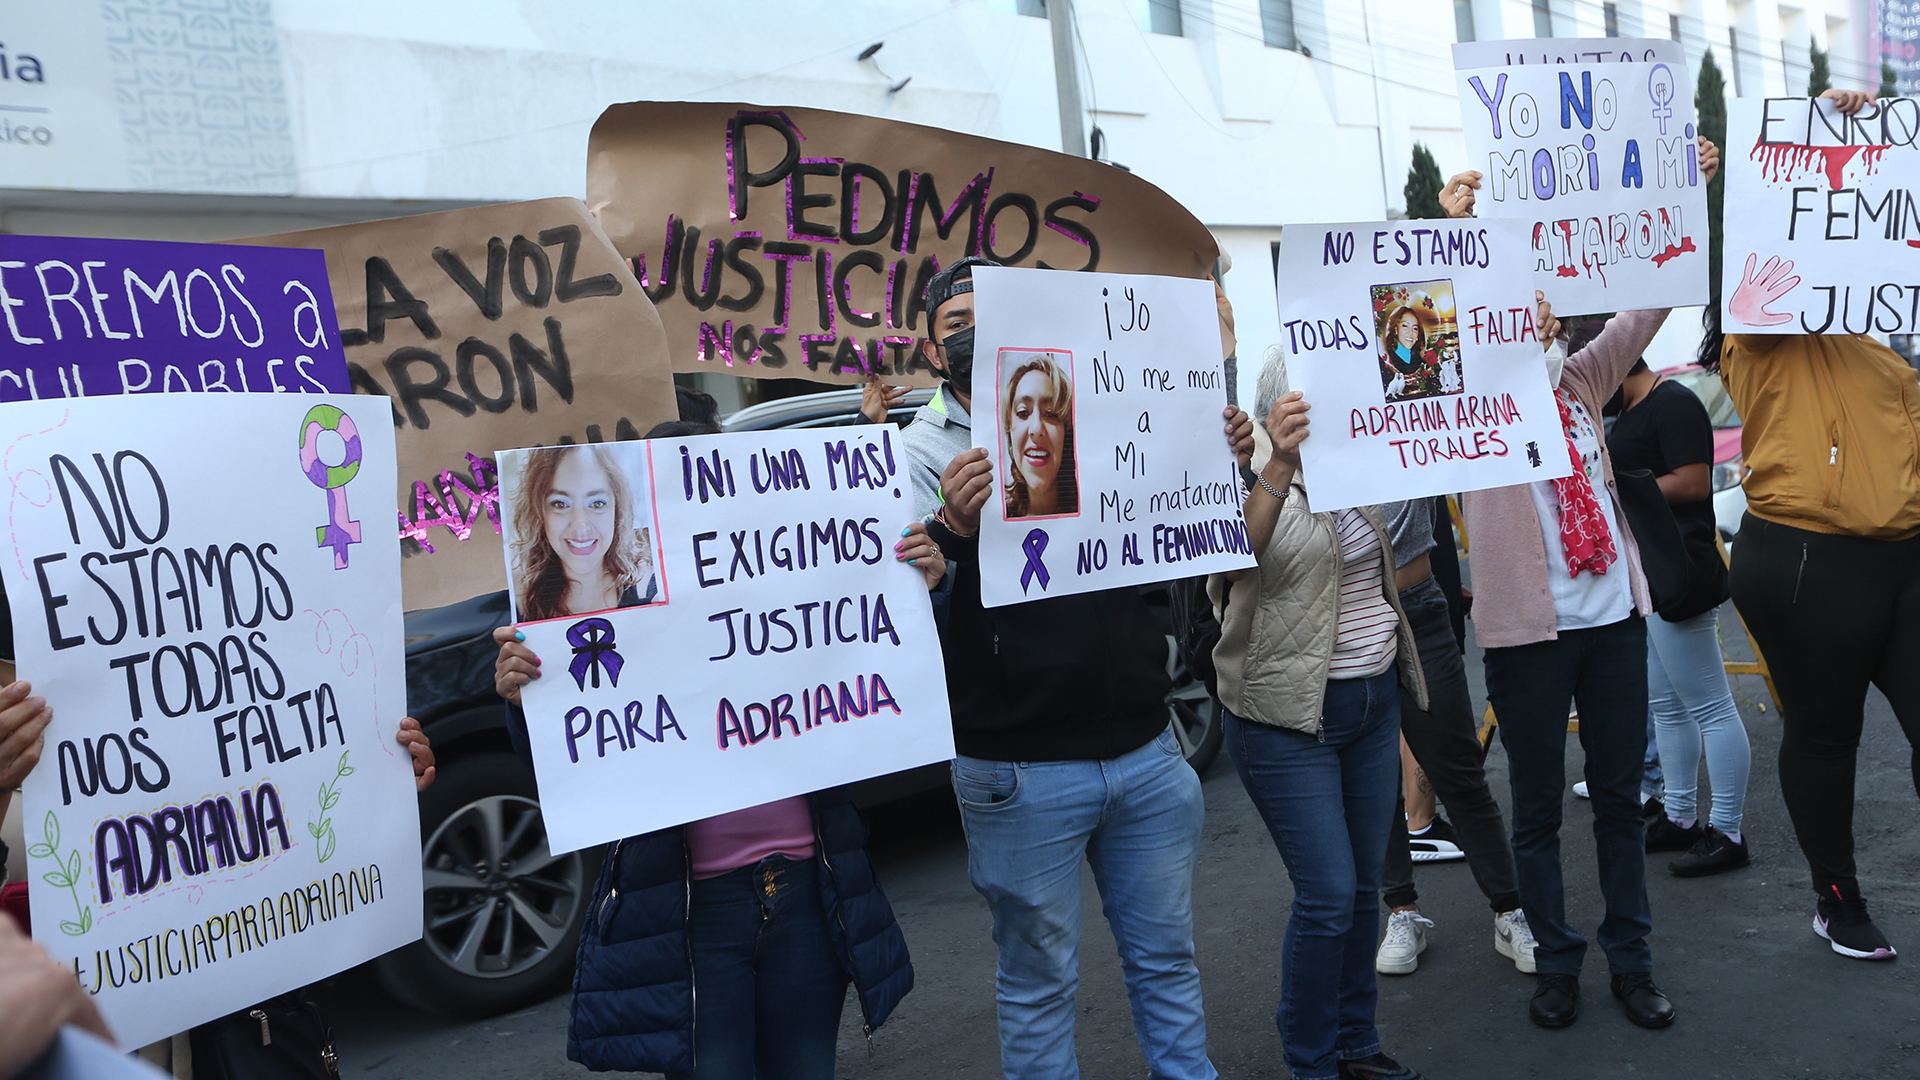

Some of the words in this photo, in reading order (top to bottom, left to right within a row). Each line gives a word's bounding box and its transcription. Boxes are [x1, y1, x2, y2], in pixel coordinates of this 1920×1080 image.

[1558, 70, 1617, 132] NO
[727, 109, 1101, 271] PEDIMOS
[1621, 138, 1643, 189] A
[431, 224, 623, 322] VOZ
[1322, 230, 1355, 266] NO
[1373, 228, 1489, 268] ESTAMOS
[284, 280, 329, 350] a
[697, 320, 788, 368] NOS
[1283, 315, 1369, 354] TODAS
[1468, 306, 1538, 345] FALTA
[1093, 350, 1126, 394] No
[1143, 367, 1176, 392] me
[1188, 364, 1222, 391] mori
[1138, 411, 1151, 434] a
[1350, 400, 1451, 438] ADRIANA
[1455, 392, 1523, 428] ARANA
[1389, 430, 1509, 468] TORALES
[750, 448, 811, 495] UNA
[824, 430, 902, 499] MÁS!
[1101, 490, 1136, 524] Me
[1150, 461, 1243, 518] mataron!
[49, 449, 170, 550] NO
[692, 517, 883, 589] EXIGIMOS
[1076, 538, 1108, 576] NO
[1121, 532, 1144, 567] AL
[1153, 518, 1254, 565] FEMINICIDIO
[33, 542, 293, 651] ESTAMOS
[708, 593, 901, 661] JUSTICIA
[109, 631, 286, 722] TODAS
[57, 727, 171, 805] NOS
[213, 683, 346, 778] FALTA
[564, 695, 687, 763] PARA
[716, 673, 902, 751] ADRIANA
[93, 783, 292, 905] ADRIANA
